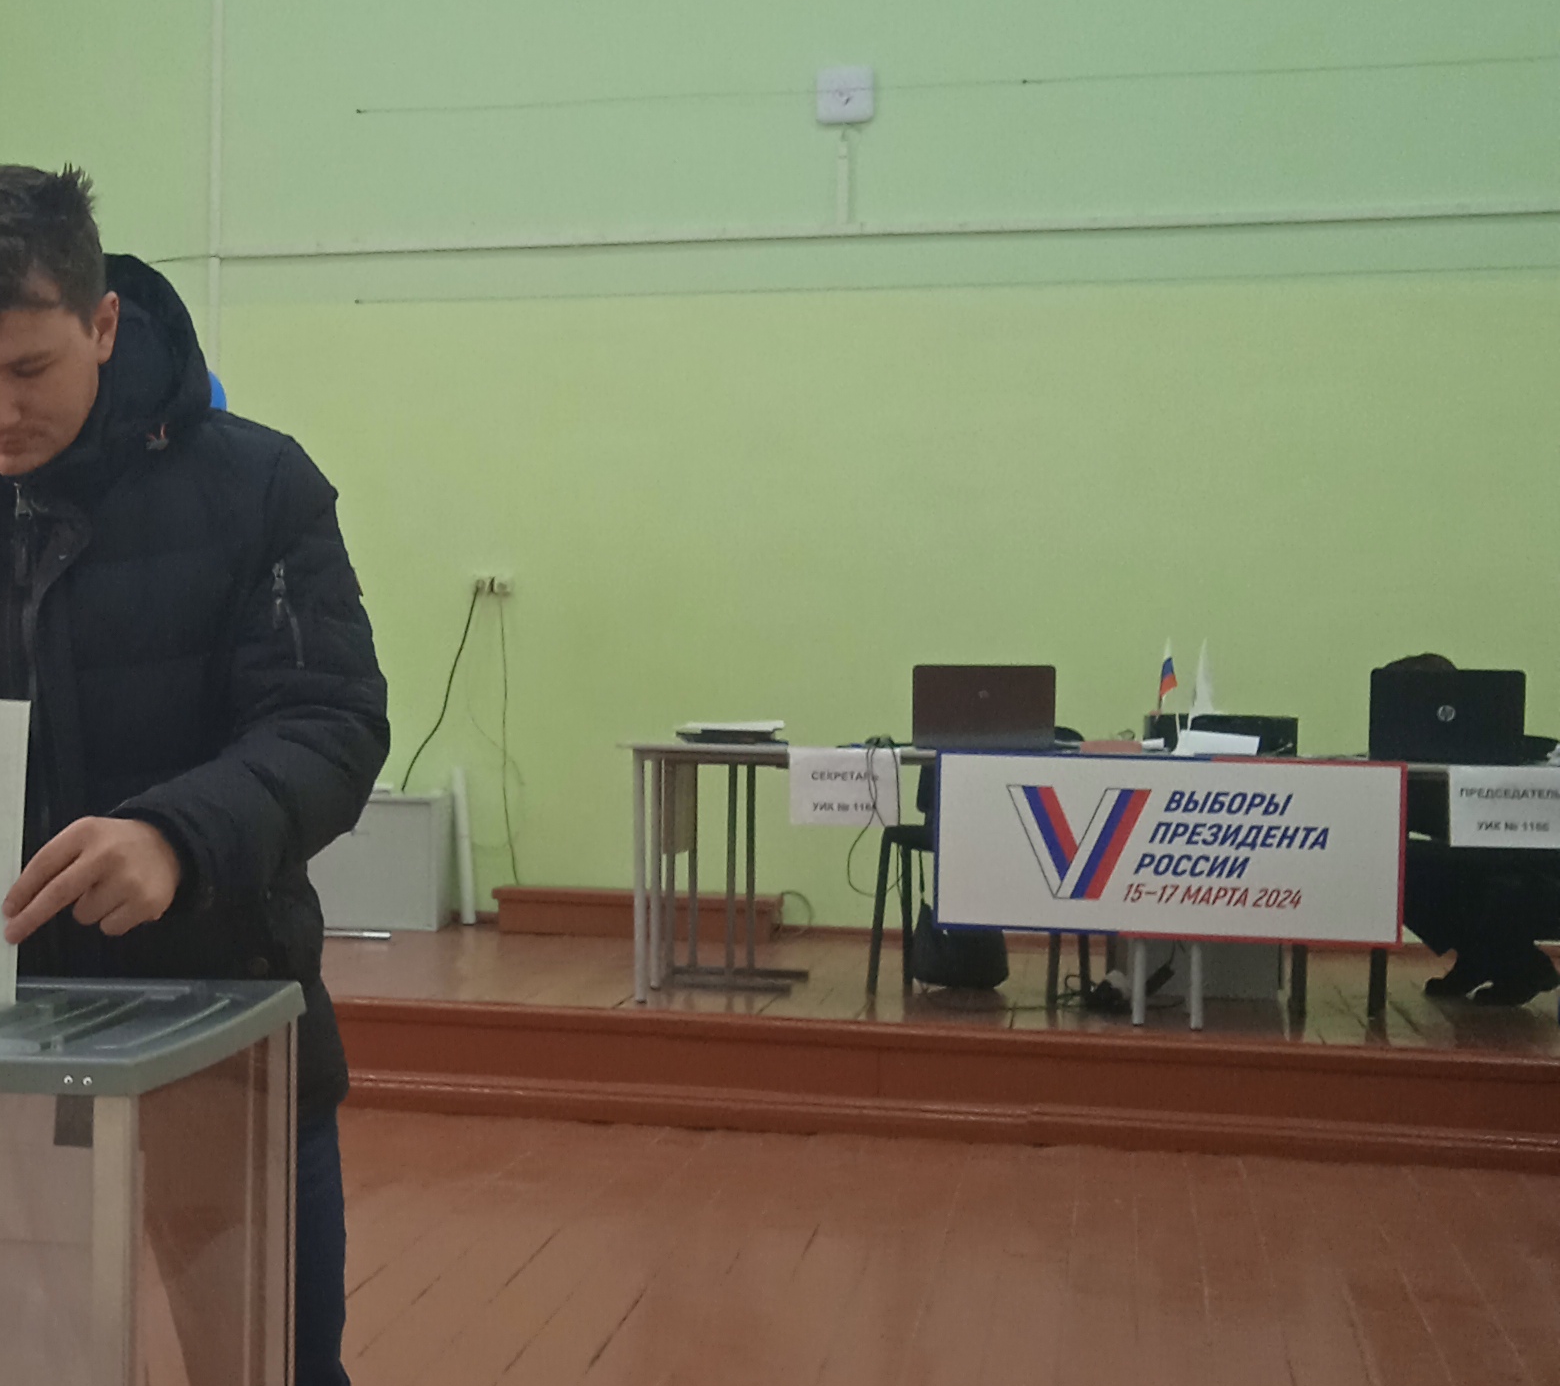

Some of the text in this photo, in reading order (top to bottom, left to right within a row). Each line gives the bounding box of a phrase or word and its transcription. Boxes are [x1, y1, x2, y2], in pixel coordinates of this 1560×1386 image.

[1163, 790, 1293, 817] ВЫБОРЫ
[1148, 821, 1330, 851] ПРЕЗИДЕНТА
[1133, 853, 1251, 879] РОССИИ
[1179, 884, 1249, 908] МАРТА
[1251, 887, 1303, 910] 2024
